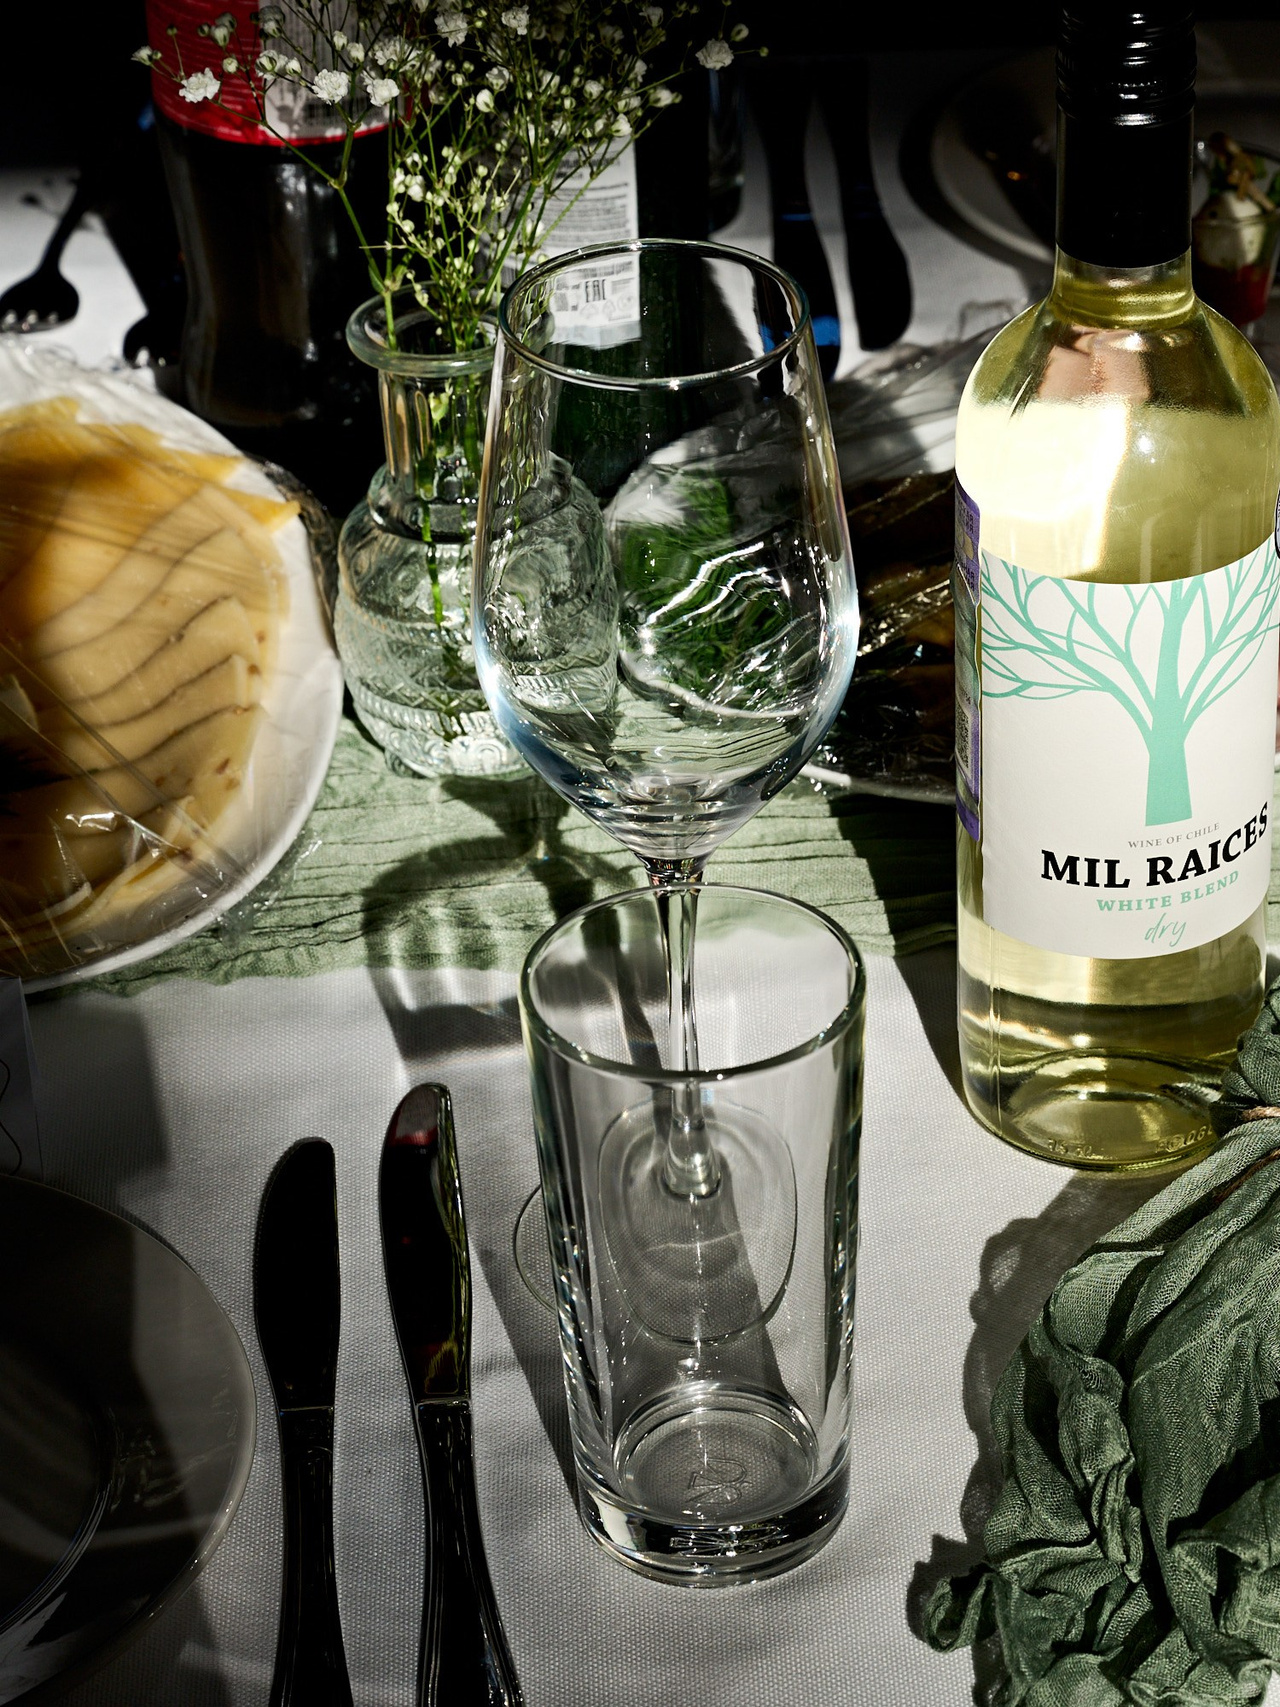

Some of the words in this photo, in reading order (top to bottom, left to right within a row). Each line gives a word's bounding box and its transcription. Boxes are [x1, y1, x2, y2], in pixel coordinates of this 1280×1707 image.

[1041, 849, 1131, 889] MIL
[1146, 801, 1268, 887] RAICES
[1128, 838, 1162, 849] WINE
[1166, 834, 1183, 845] OF
[1186, 823, 1220, 840] CHILE
[1096, 895, 1172, 912] WHITE
[1180, 870, 1239, 904] BLEND
[1144, 912, 1187, 948] dry
